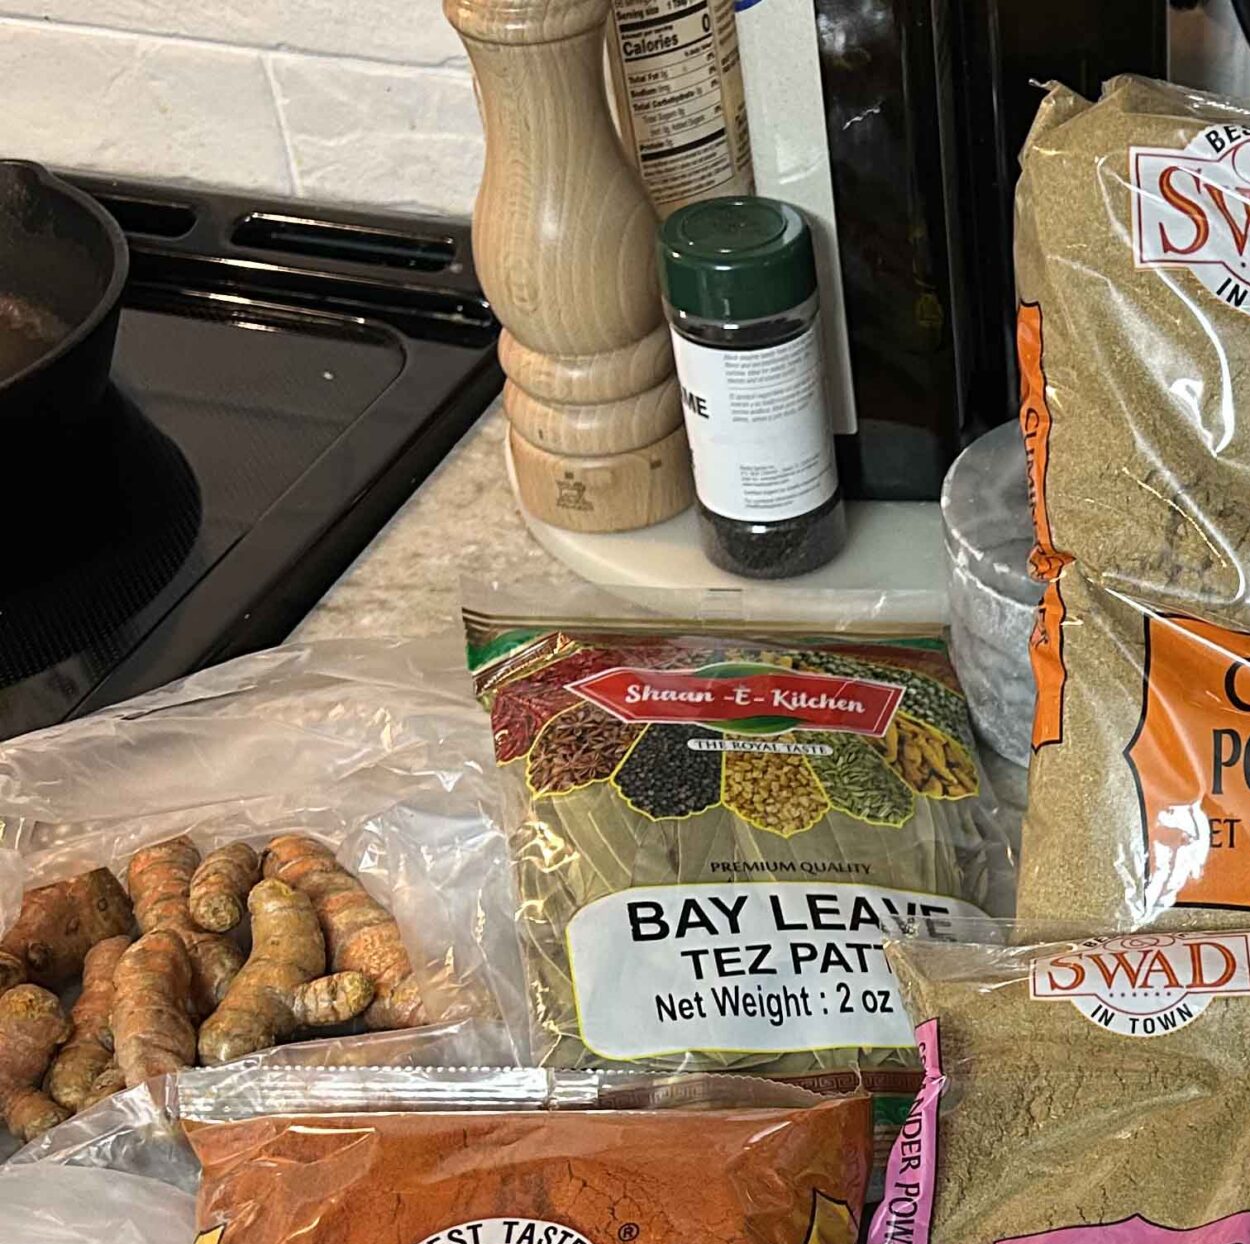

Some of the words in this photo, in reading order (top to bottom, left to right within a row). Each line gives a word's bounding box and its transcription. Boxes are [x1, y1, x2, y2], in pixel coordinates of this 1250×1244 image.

[622, 34, 679, 57] Calories
[702, 13, 711, 33] 0
[1216, 277, 1249, 308] IN
[625, 684, 715, 705] Shaan
[770, 688, 866, 715] Kitchen
[697, 740, 726, 750] THE
[733, 741, 778, 752] ROYAL
[785, 743, 828, 755] TASTE
[710, 860, 797, 874] PREMIUM
[800, 861, 872, 875] QUALITY
[626, 895, 749, 942] BAY
[680, 943, 778, 980] TEZ
[1047, 941, 1238, 992] SWAD
[655, 992, 707, 1023] Net
[711, 984, 813, 1027] Weight
[835, 981, 854, 1014] 2
[861, 989, 894, 1014] oz
[1090, 1004, 1116, 1027] IN
[1128, 1003, 1194, 1035] TOWN
